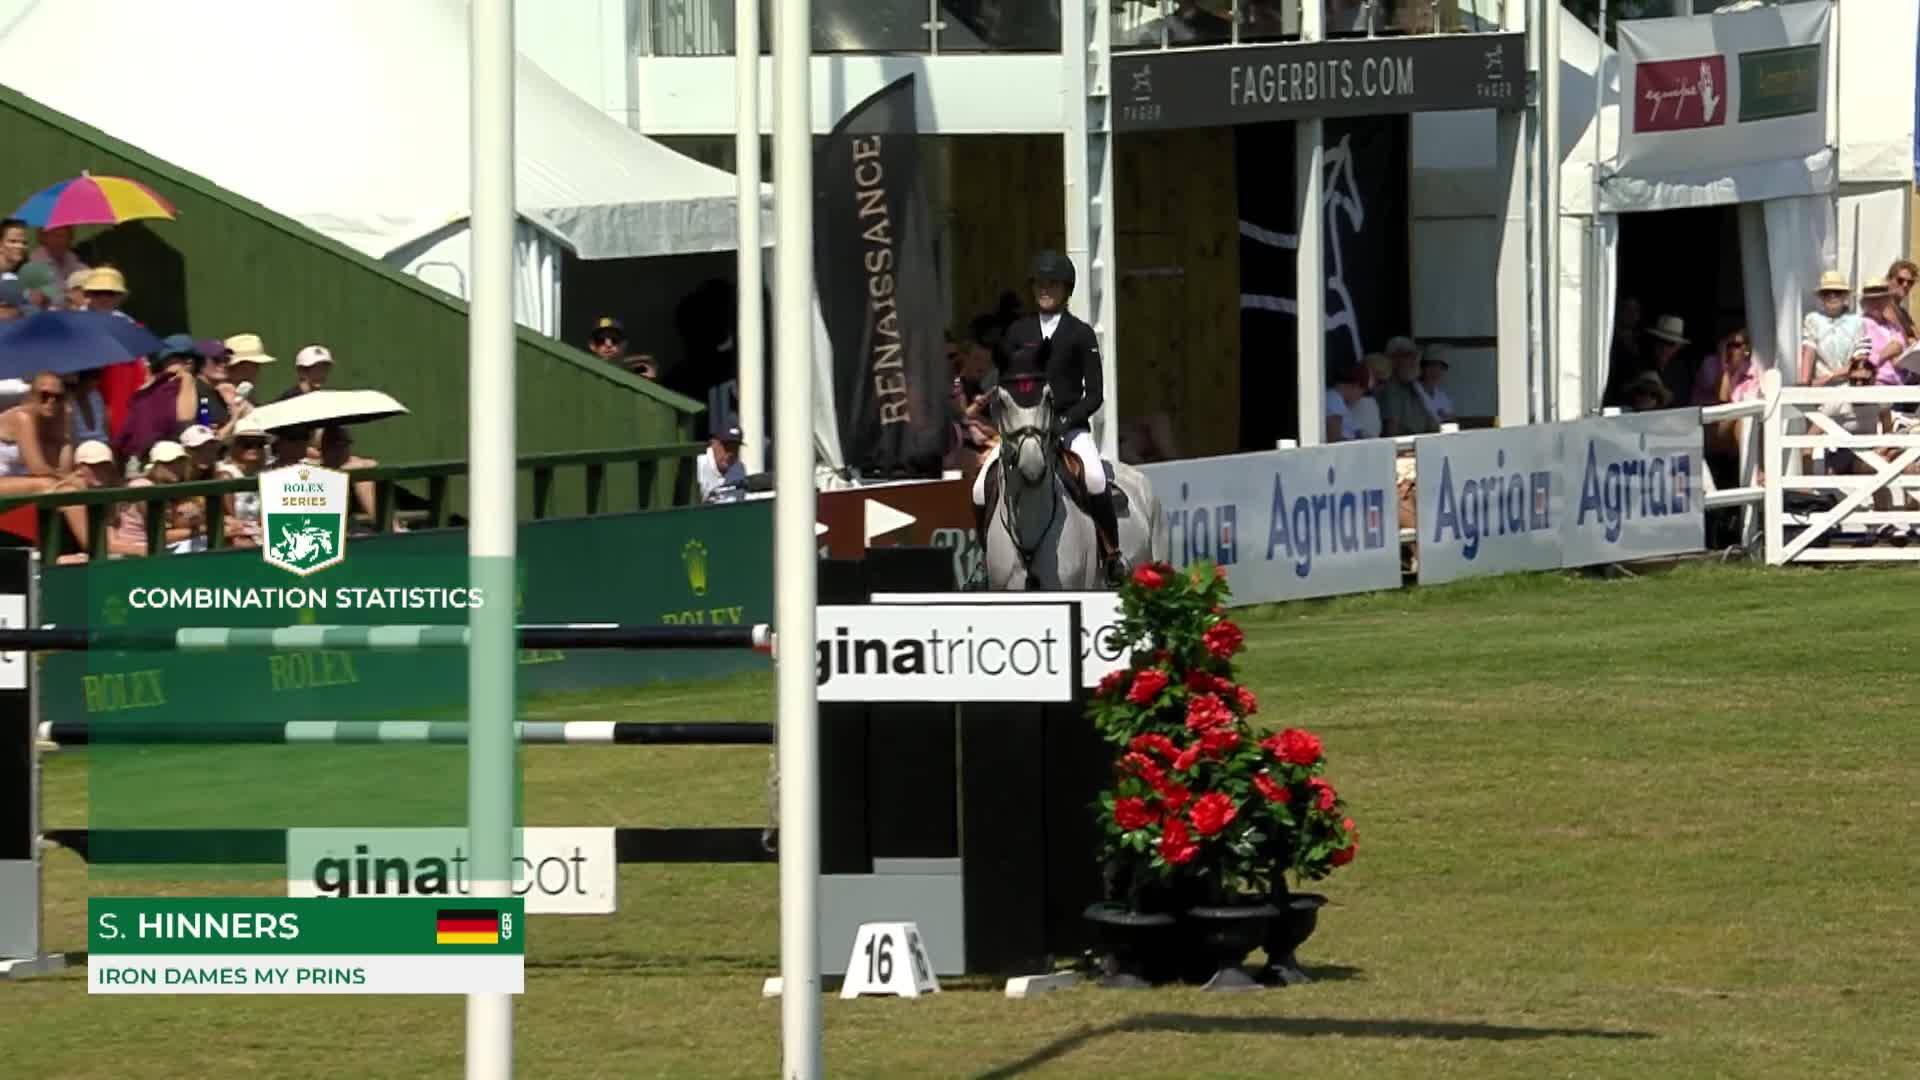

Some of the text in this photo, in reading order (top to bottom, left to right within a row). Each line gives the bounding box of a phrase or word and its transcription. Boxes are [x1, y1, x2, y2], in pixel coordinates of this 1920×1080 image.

[1230, 56, 1414, 105] FAGERBITS.COM
[853, 135, 910, 426] RENAISSANCE
[1167, 482, 1210, 566] ria
[1266, 465, 1360, 578] Agria
[1433, 449, 1526, 560] Agria
[1577, 432, 1668, 543] Agria
[314, 846, 588, 898] ginatcot
[864, 932, 894, 985] 16
